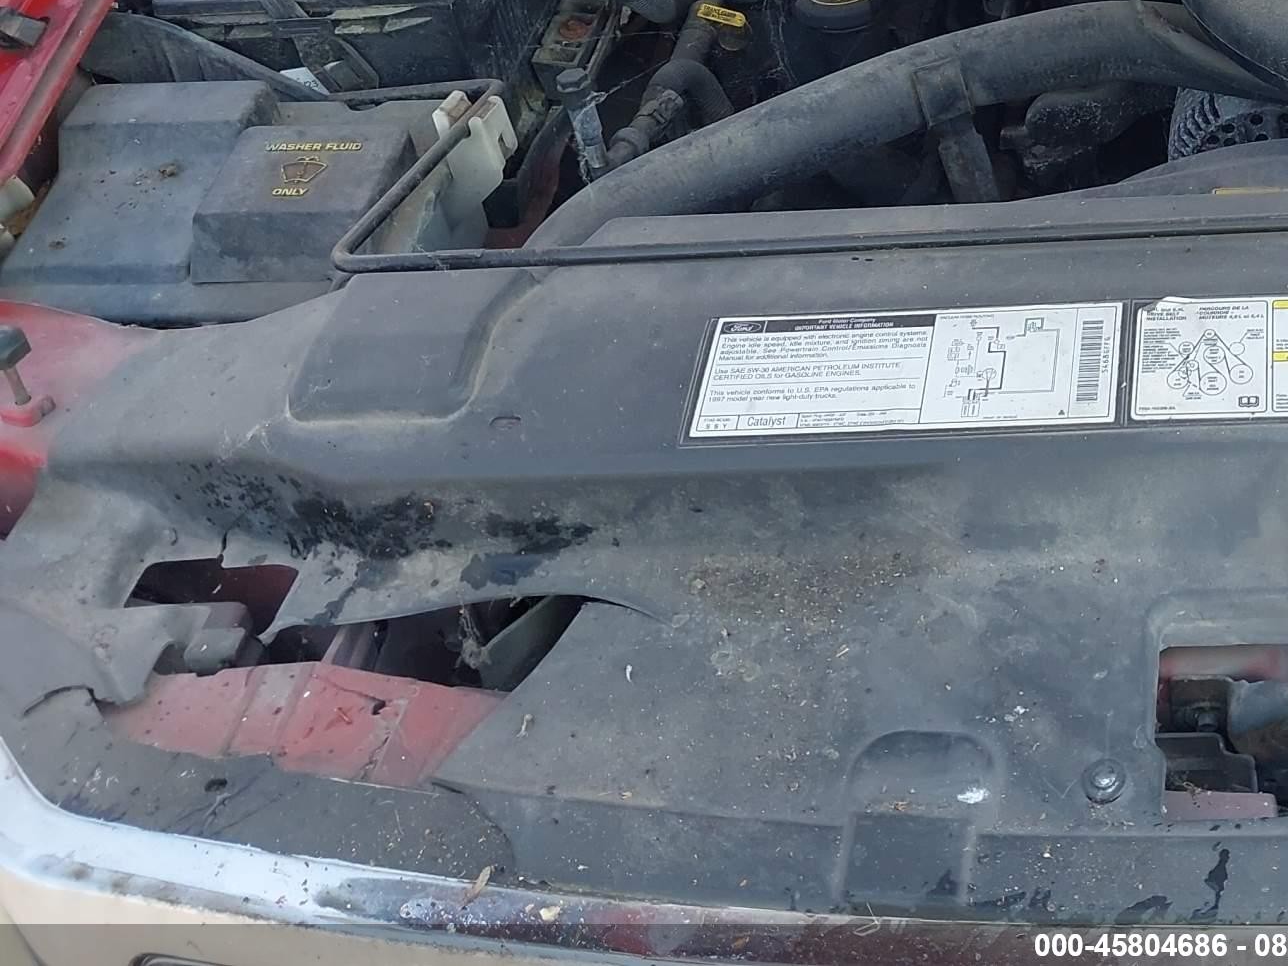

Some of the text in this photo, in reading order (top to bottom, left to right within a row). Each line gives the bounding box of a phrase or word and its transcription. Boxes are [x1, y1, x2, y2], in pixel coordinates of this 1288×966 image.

[265, 142, 362, 151] WASHER FLUID
[272, 187, 309, 196] ONLY
[861, 362, 901, 370] INSTITUTE
[747, 417, 786, 427] Catalyst
